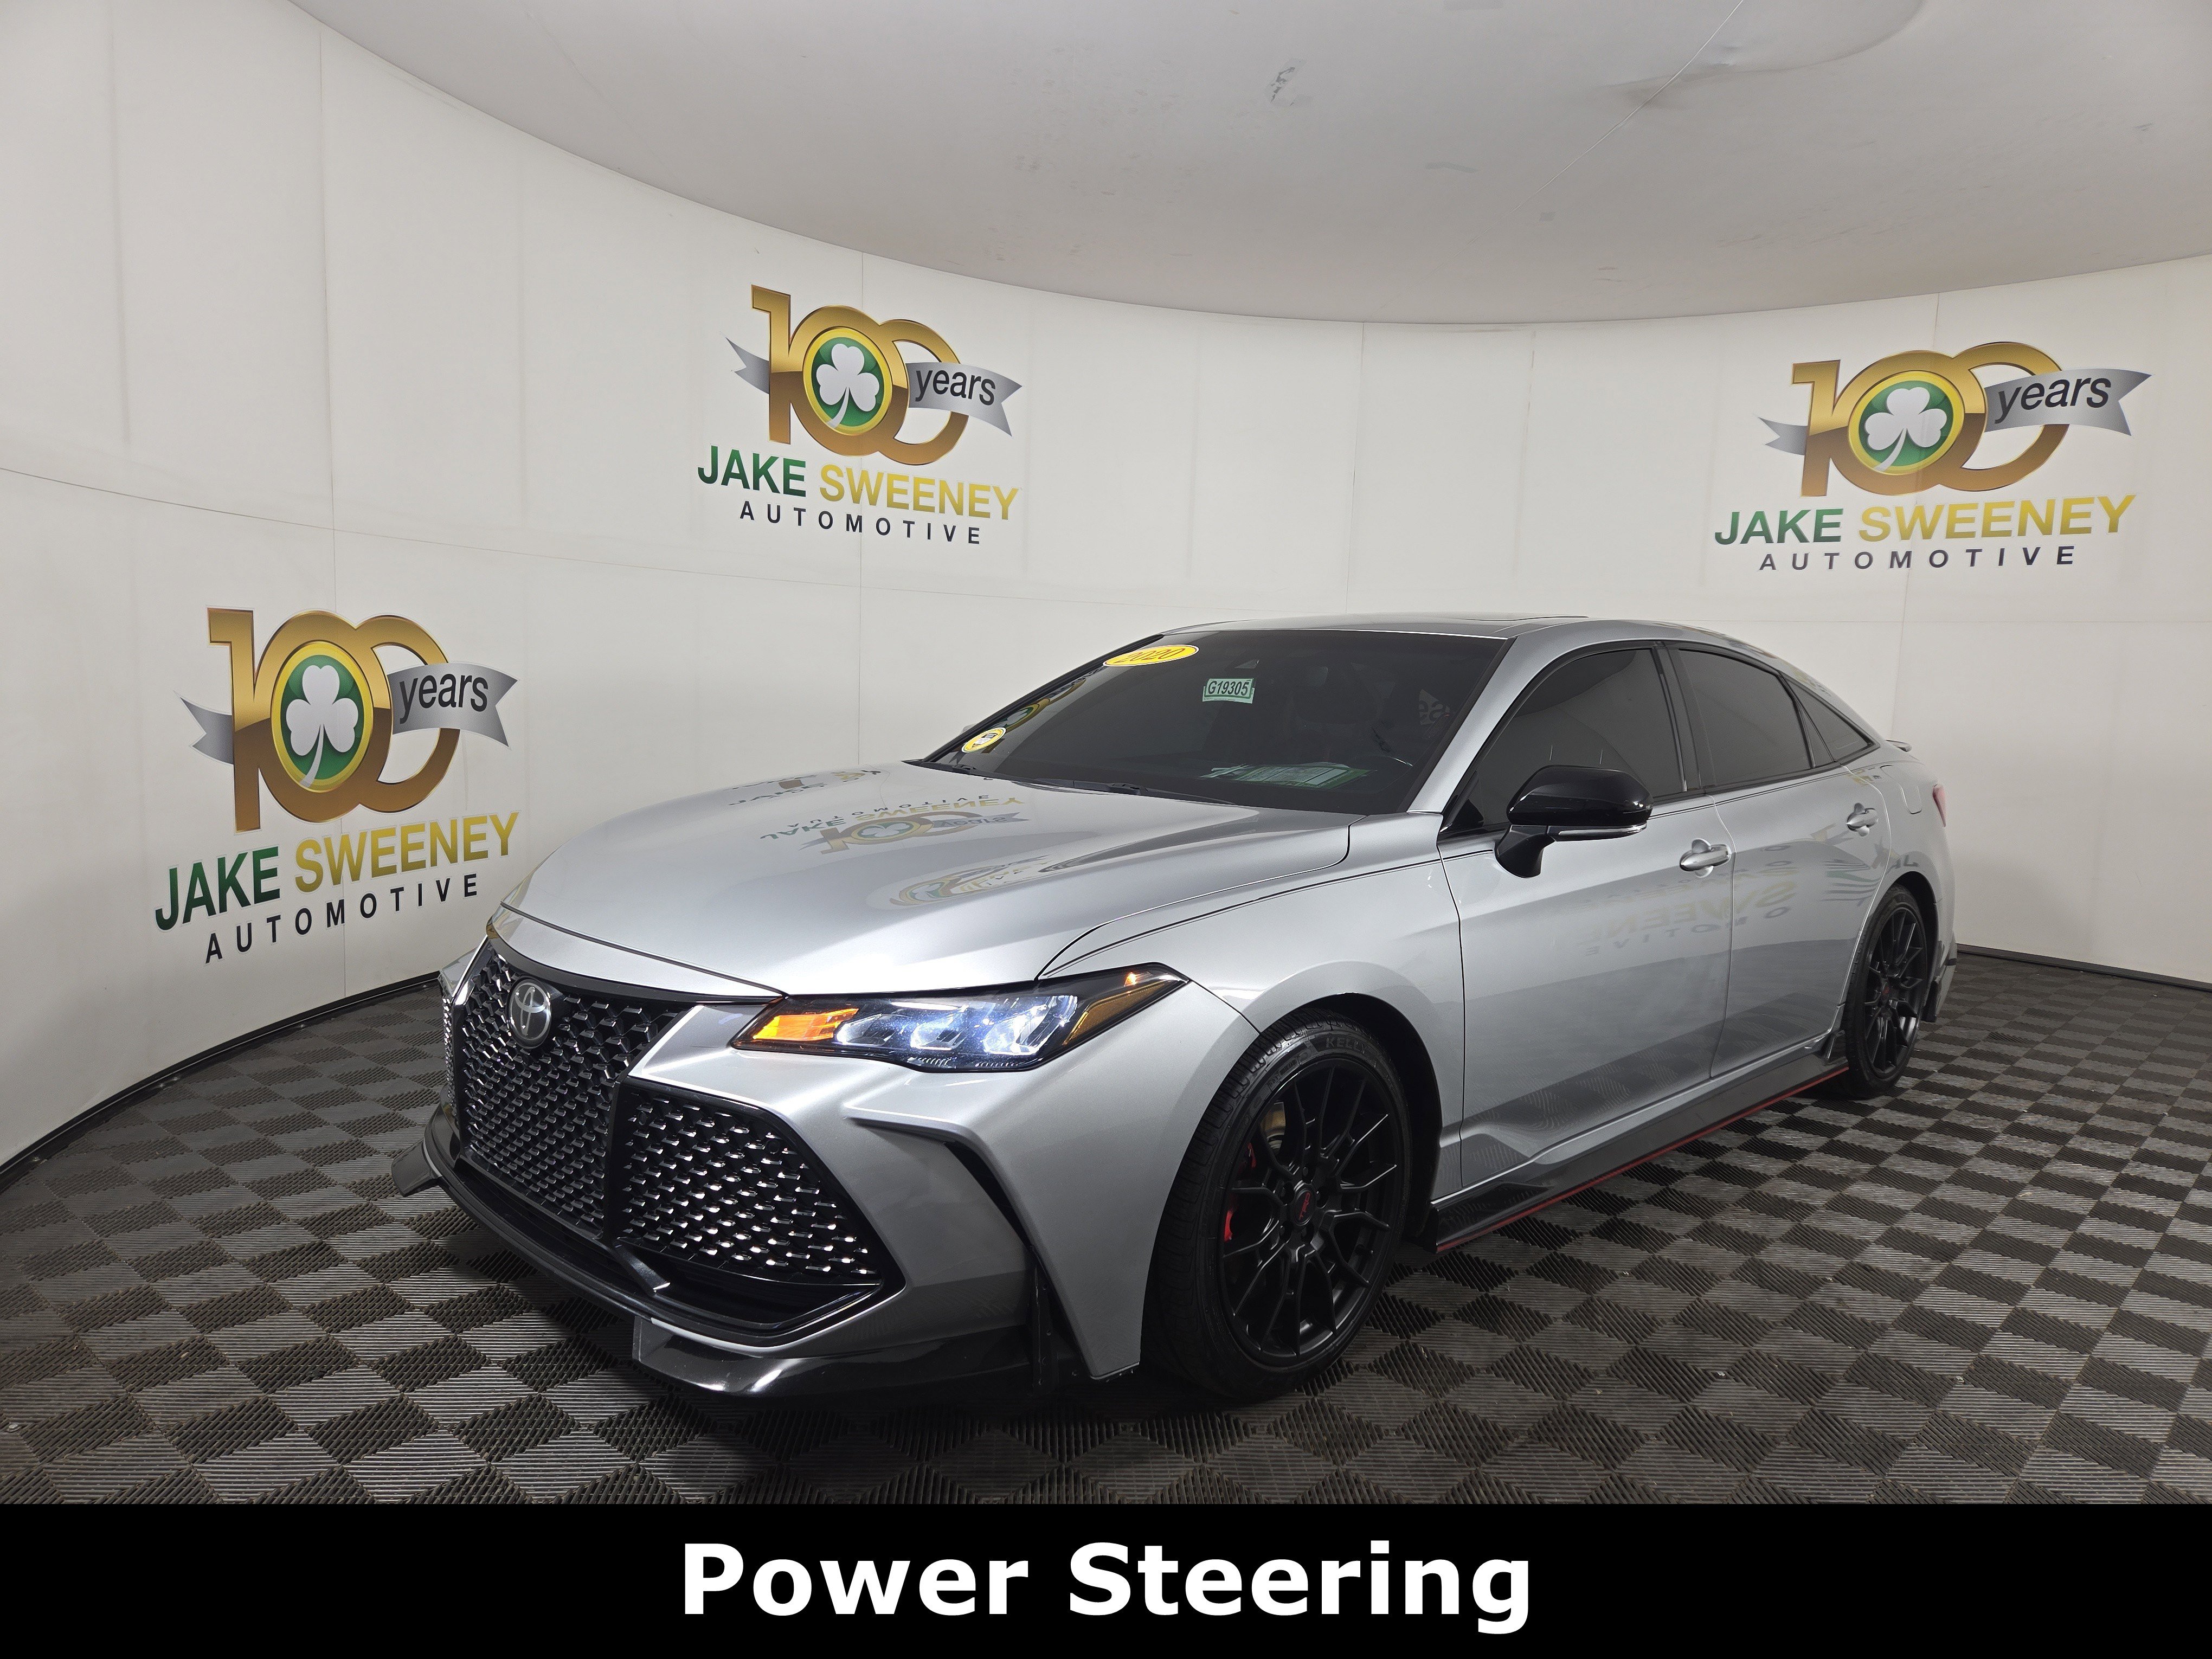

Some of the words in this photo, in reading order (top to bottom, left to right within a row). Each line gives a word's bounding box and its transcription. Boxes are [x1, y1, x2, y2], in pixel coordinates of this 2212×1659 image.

[751, 284, 969, 466] 100
[916, 369, 996, 406] years
[1792, 342, 2069, 497] 100
[1995, 376, 2112, 423] years
[698, 445, 806, 497] JAKE
[820, 465, 1018, 520] SWEENEY
[740, 501, 980, 545] AUTOMOTIVE
[1715, 509, 1843, 545] JAKE
[1859, 494, 2137, 542] SWEENEY
[1759, 545, 2075, 570] AUTOMOTIVE
[1113, 648, 1186, 664] 2020
[1208, 680, 1250, 696] G19305
[208, 608, 460, 832] 100
[399, 673, 488, 724] years
[155, 846, 280, 930] JAKE
[295, 812, 519, 892] SWEENEY
[205, 873, 477, 963] AUTOMOTIVE
[1325, 1036, 1367, 1054] KELLY
